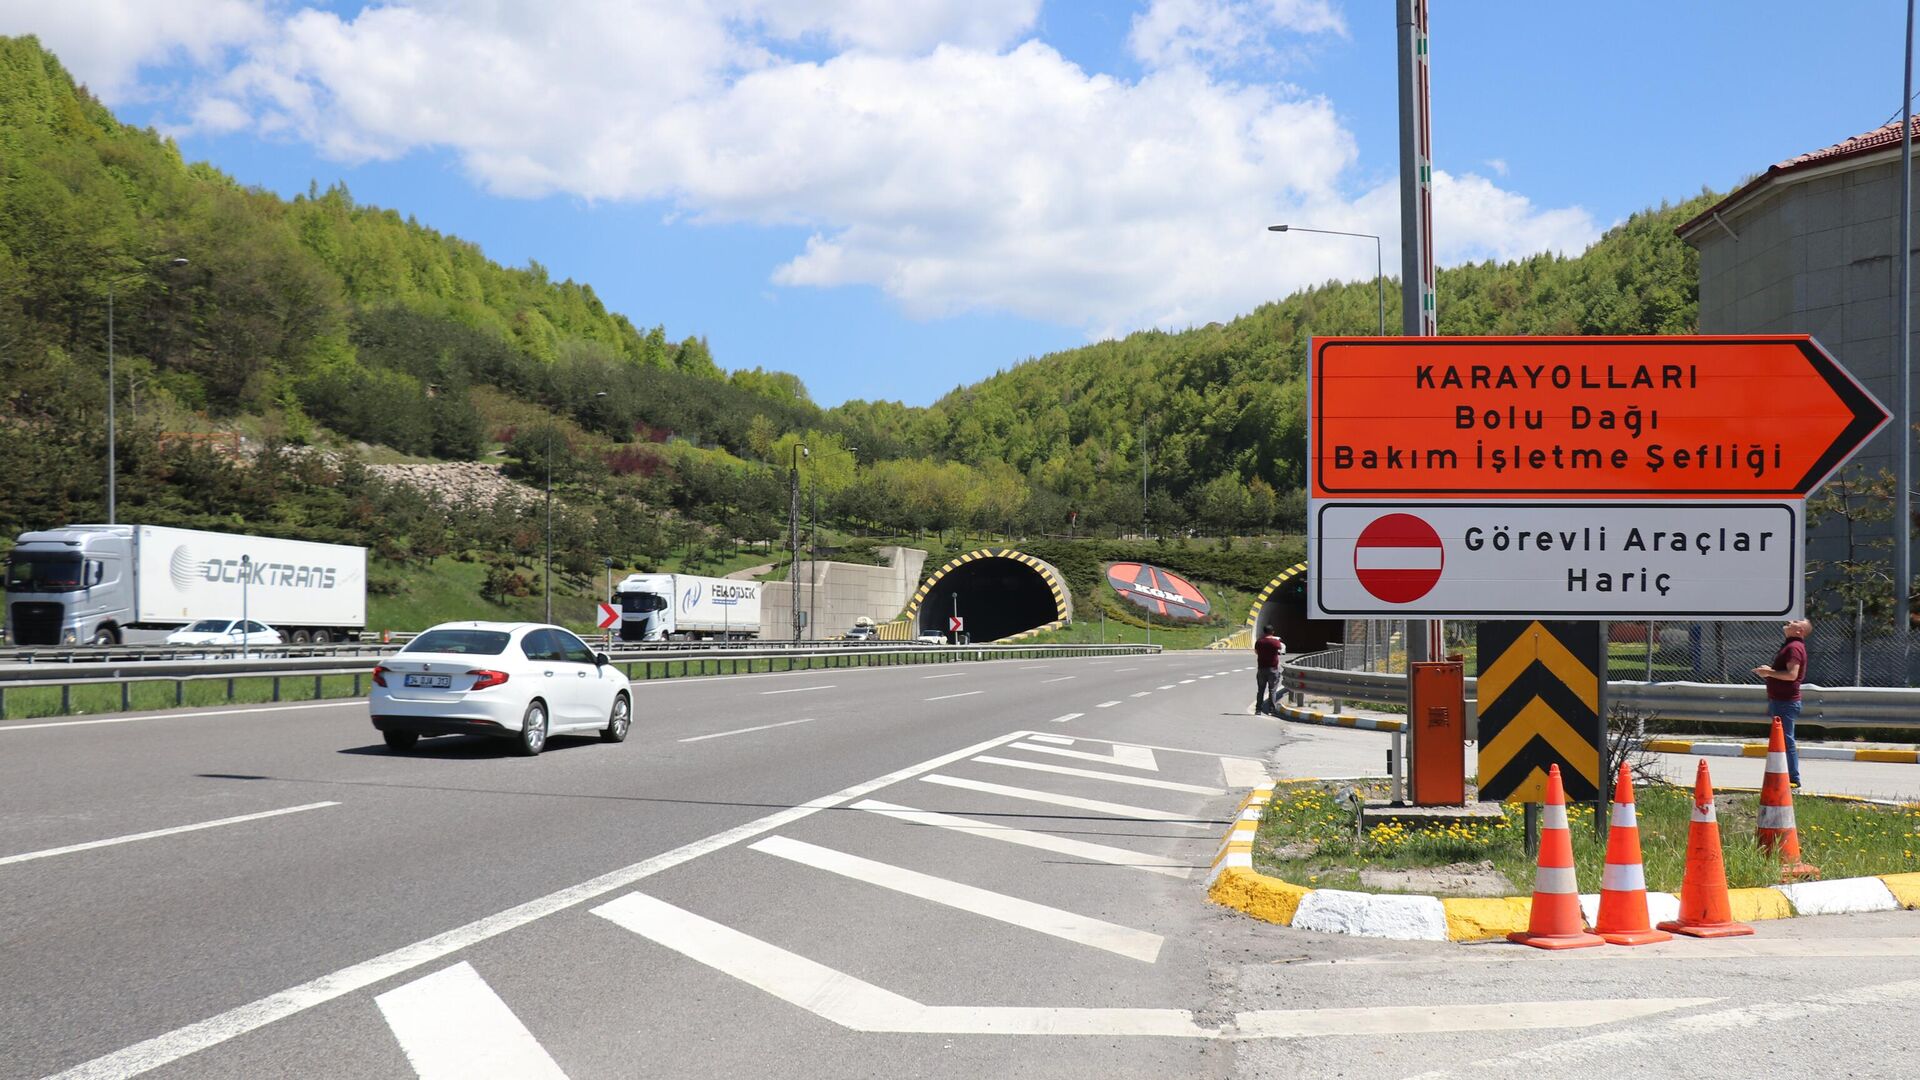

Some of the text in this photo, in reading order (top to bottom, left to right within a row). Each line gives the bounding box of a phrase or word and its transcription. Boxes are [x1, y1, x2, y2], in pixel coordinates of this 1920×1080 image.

[1417, 366, 1697, 389] KARAYOLLARI
[1456, 406, 1658, 439] Bolu Dağı
[1335, 440, 1781, 478] Bakım İşletme Şefliği
[1465, 526, 1774, 556] Görevli Araçlar
[206, 558, 336, 589] OCAKTRANS
[1568, 568, 1671, 597] Hariç
[1134, 583, 1186, 604] KGM
